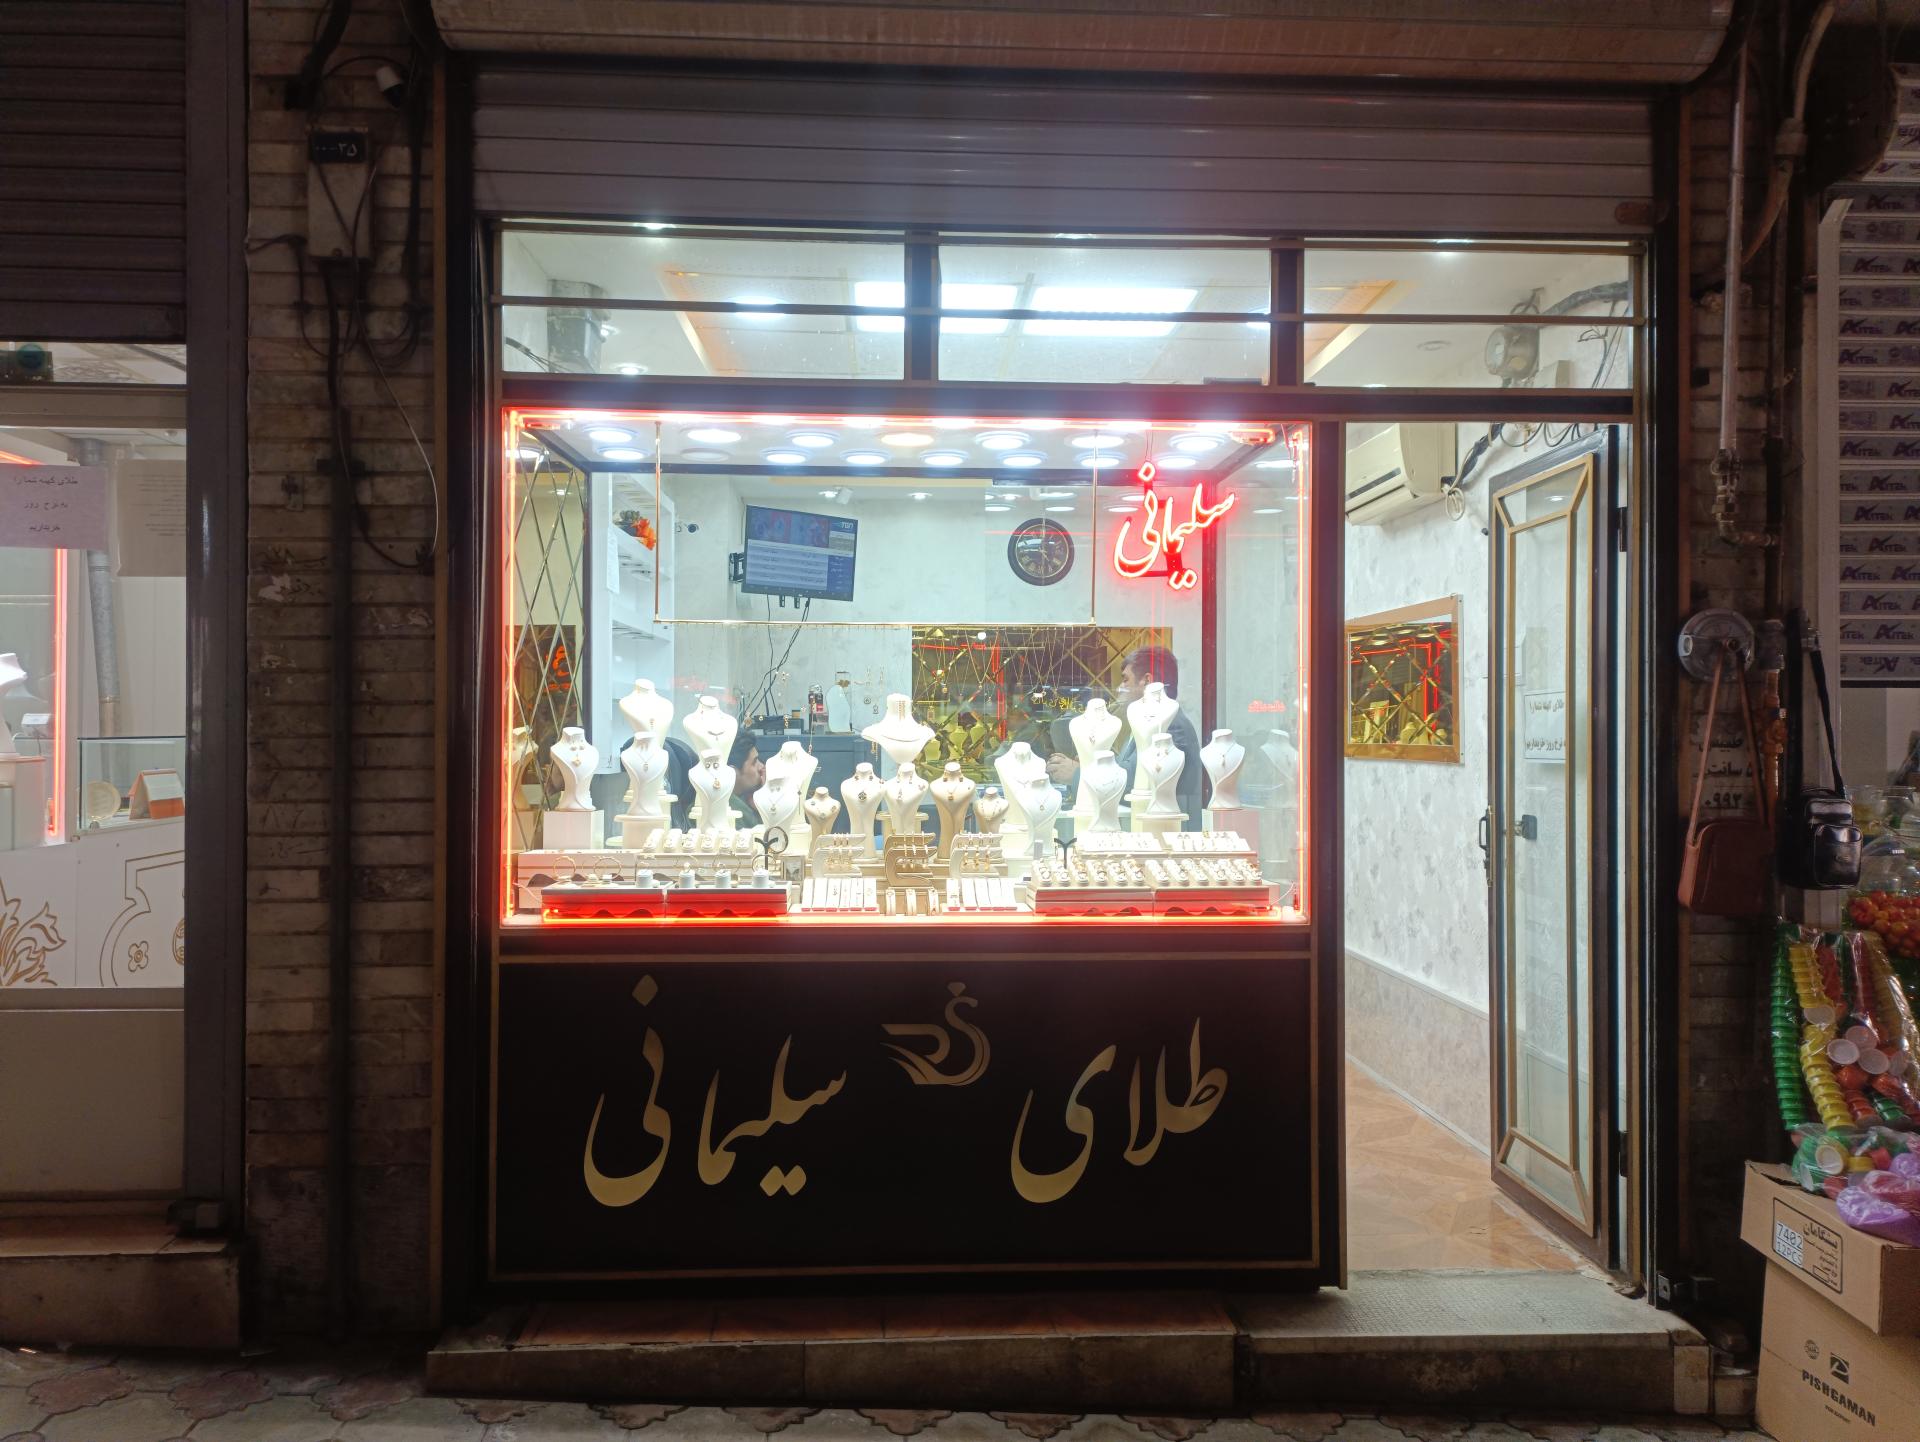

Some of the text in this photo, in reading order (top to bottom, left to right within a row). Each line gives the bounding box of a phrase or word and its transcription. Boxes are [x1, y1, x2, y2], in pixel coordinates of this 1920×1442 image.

[1114, 462, 1235, 589] سلیمانی
[584, 974, 1228, 1207] طلای سلیمانی
[1801, 1369, 1876, 1427] PISHGAMAN
